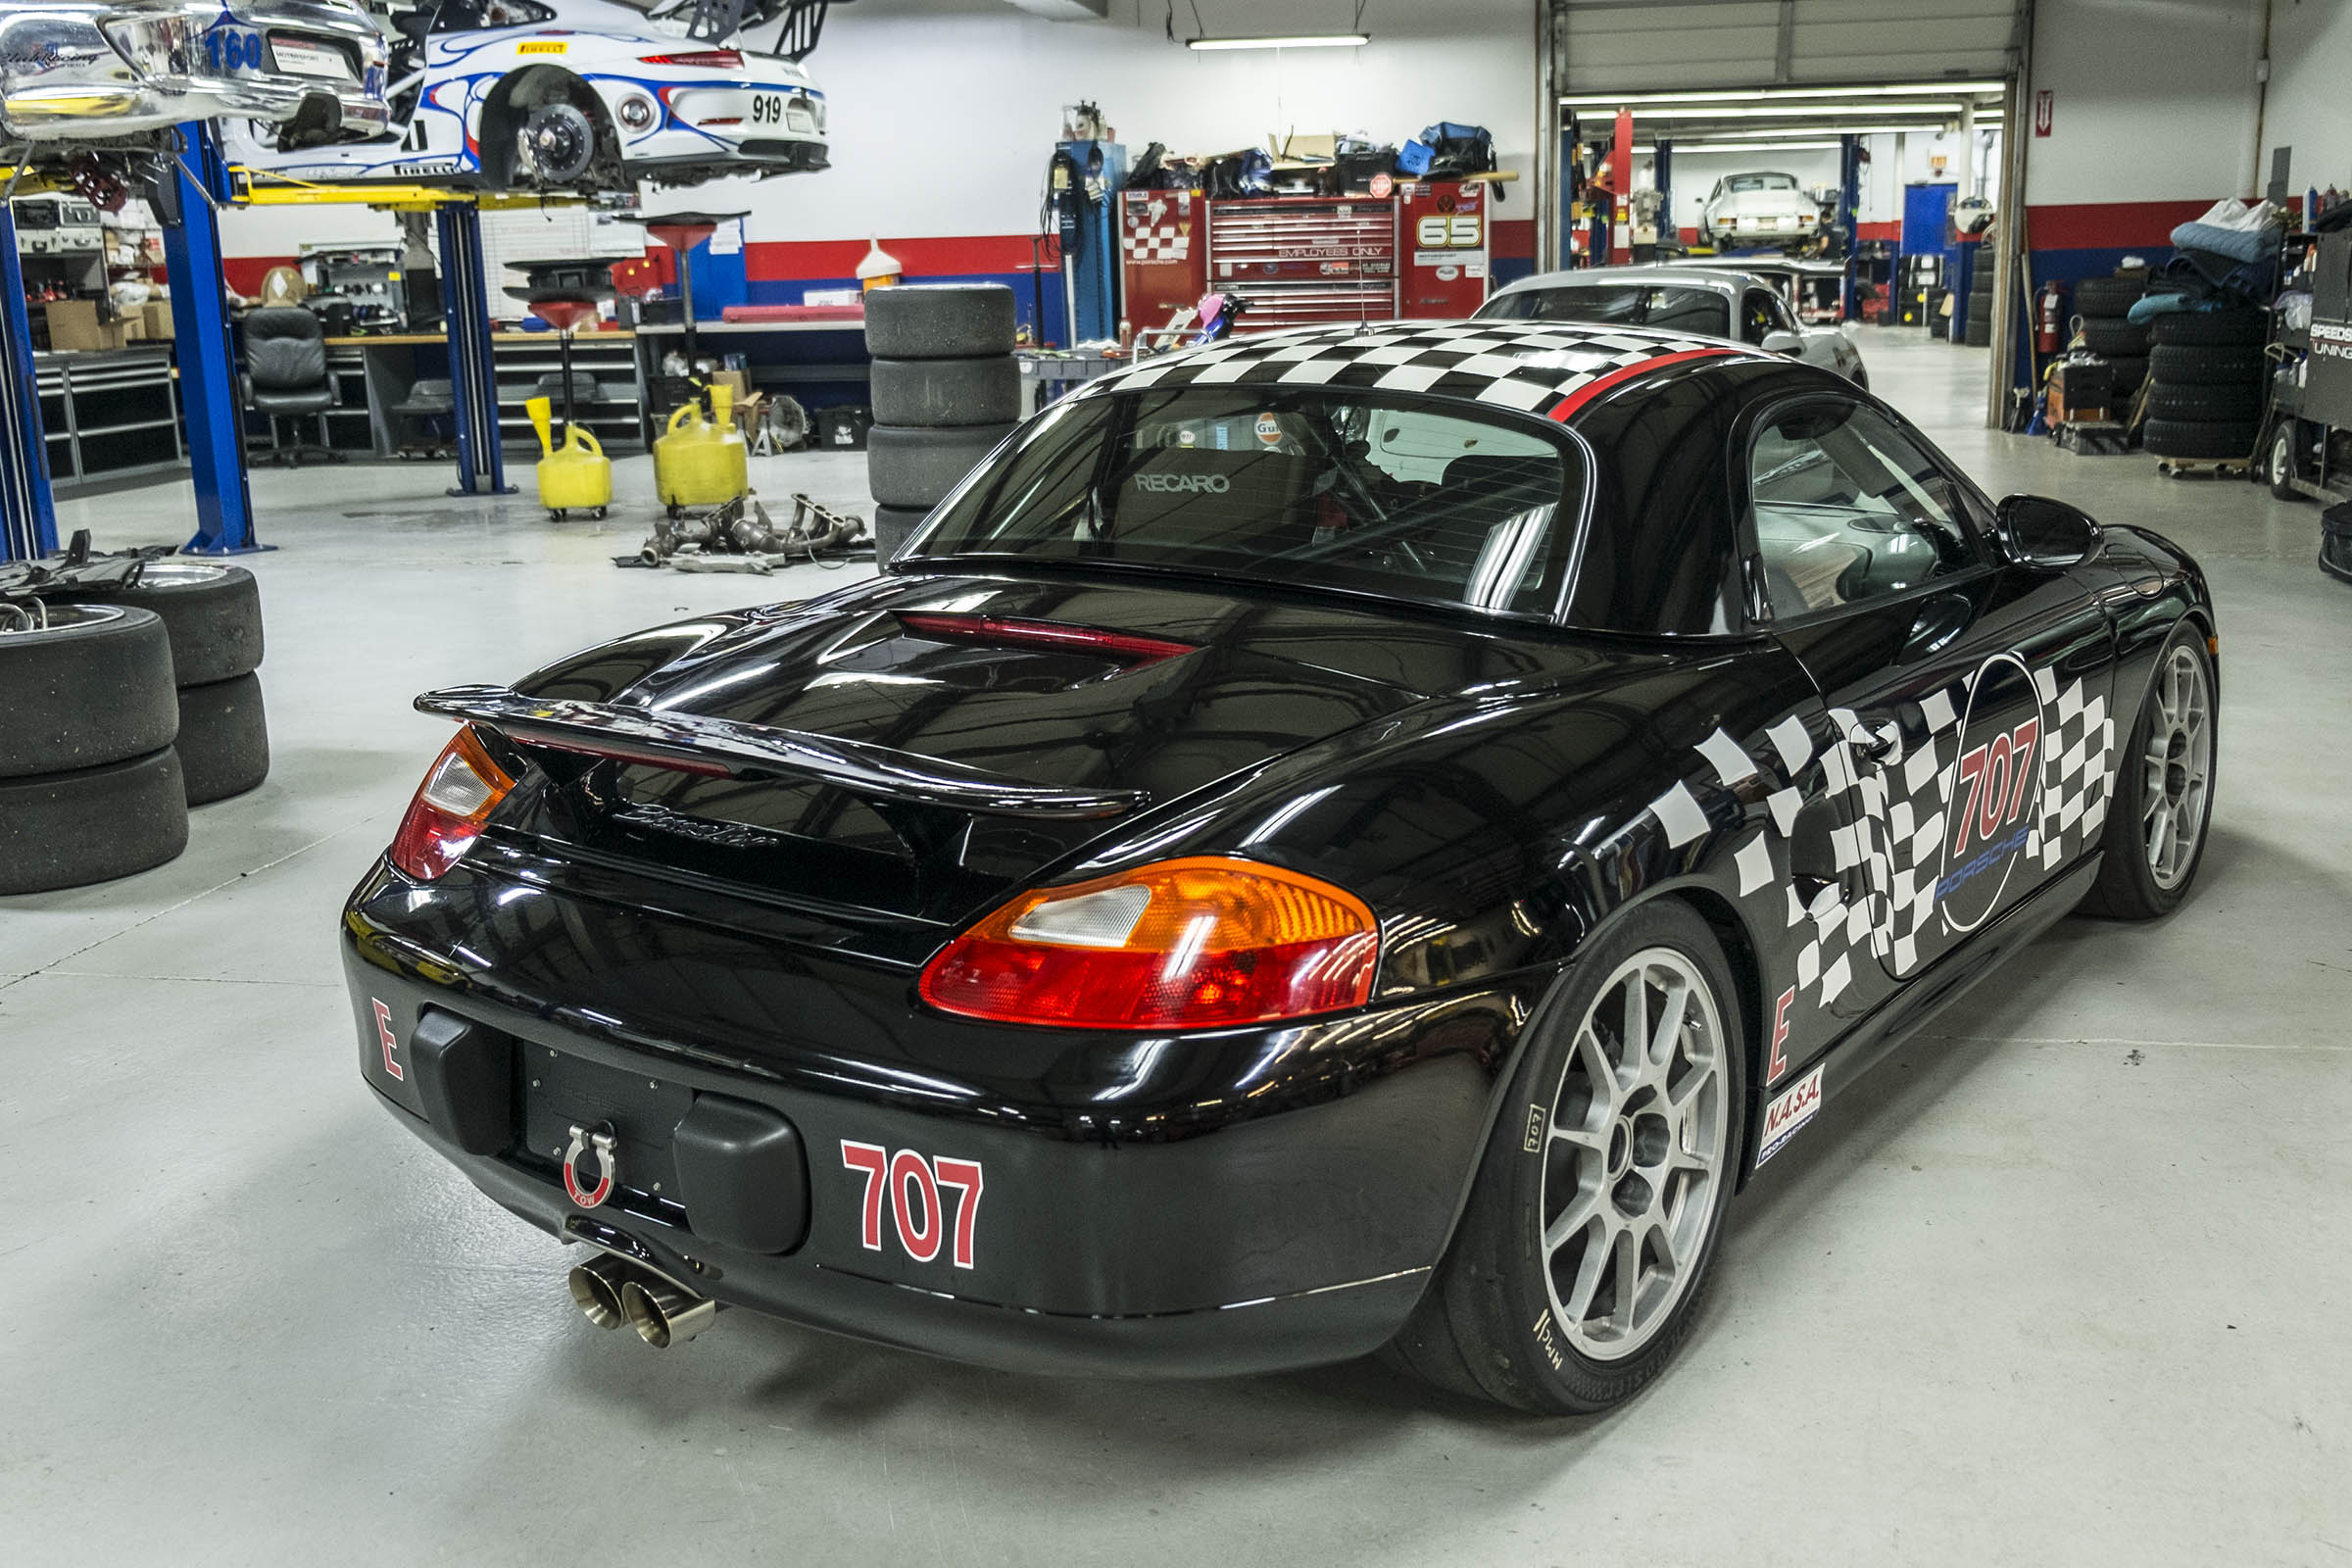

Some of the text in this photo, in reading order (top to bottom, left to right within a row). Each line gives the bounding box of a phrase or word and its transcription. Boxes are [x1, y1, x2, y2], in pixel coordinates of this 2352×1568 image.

[41, 51, 101, 68] Racing
[205, 30, 262, 70] 160
[753, 94, 781, 123] 919
[1416, 216, 1482, 248] 65
[1278, 247, 1383, 257] EMPLOYEES ONLY
[1135, 473, 1231, 494] RECARO
[1953, 715, 2039, 859] 707
[1934, 824, 2030, 903] PORSCHE
[371, 996, 404, 1082] E
[1766, 984, 1795, 1088] E
[572, 1189, 595, 1205] TOW
[840, 1139, 984, 1270] 707
